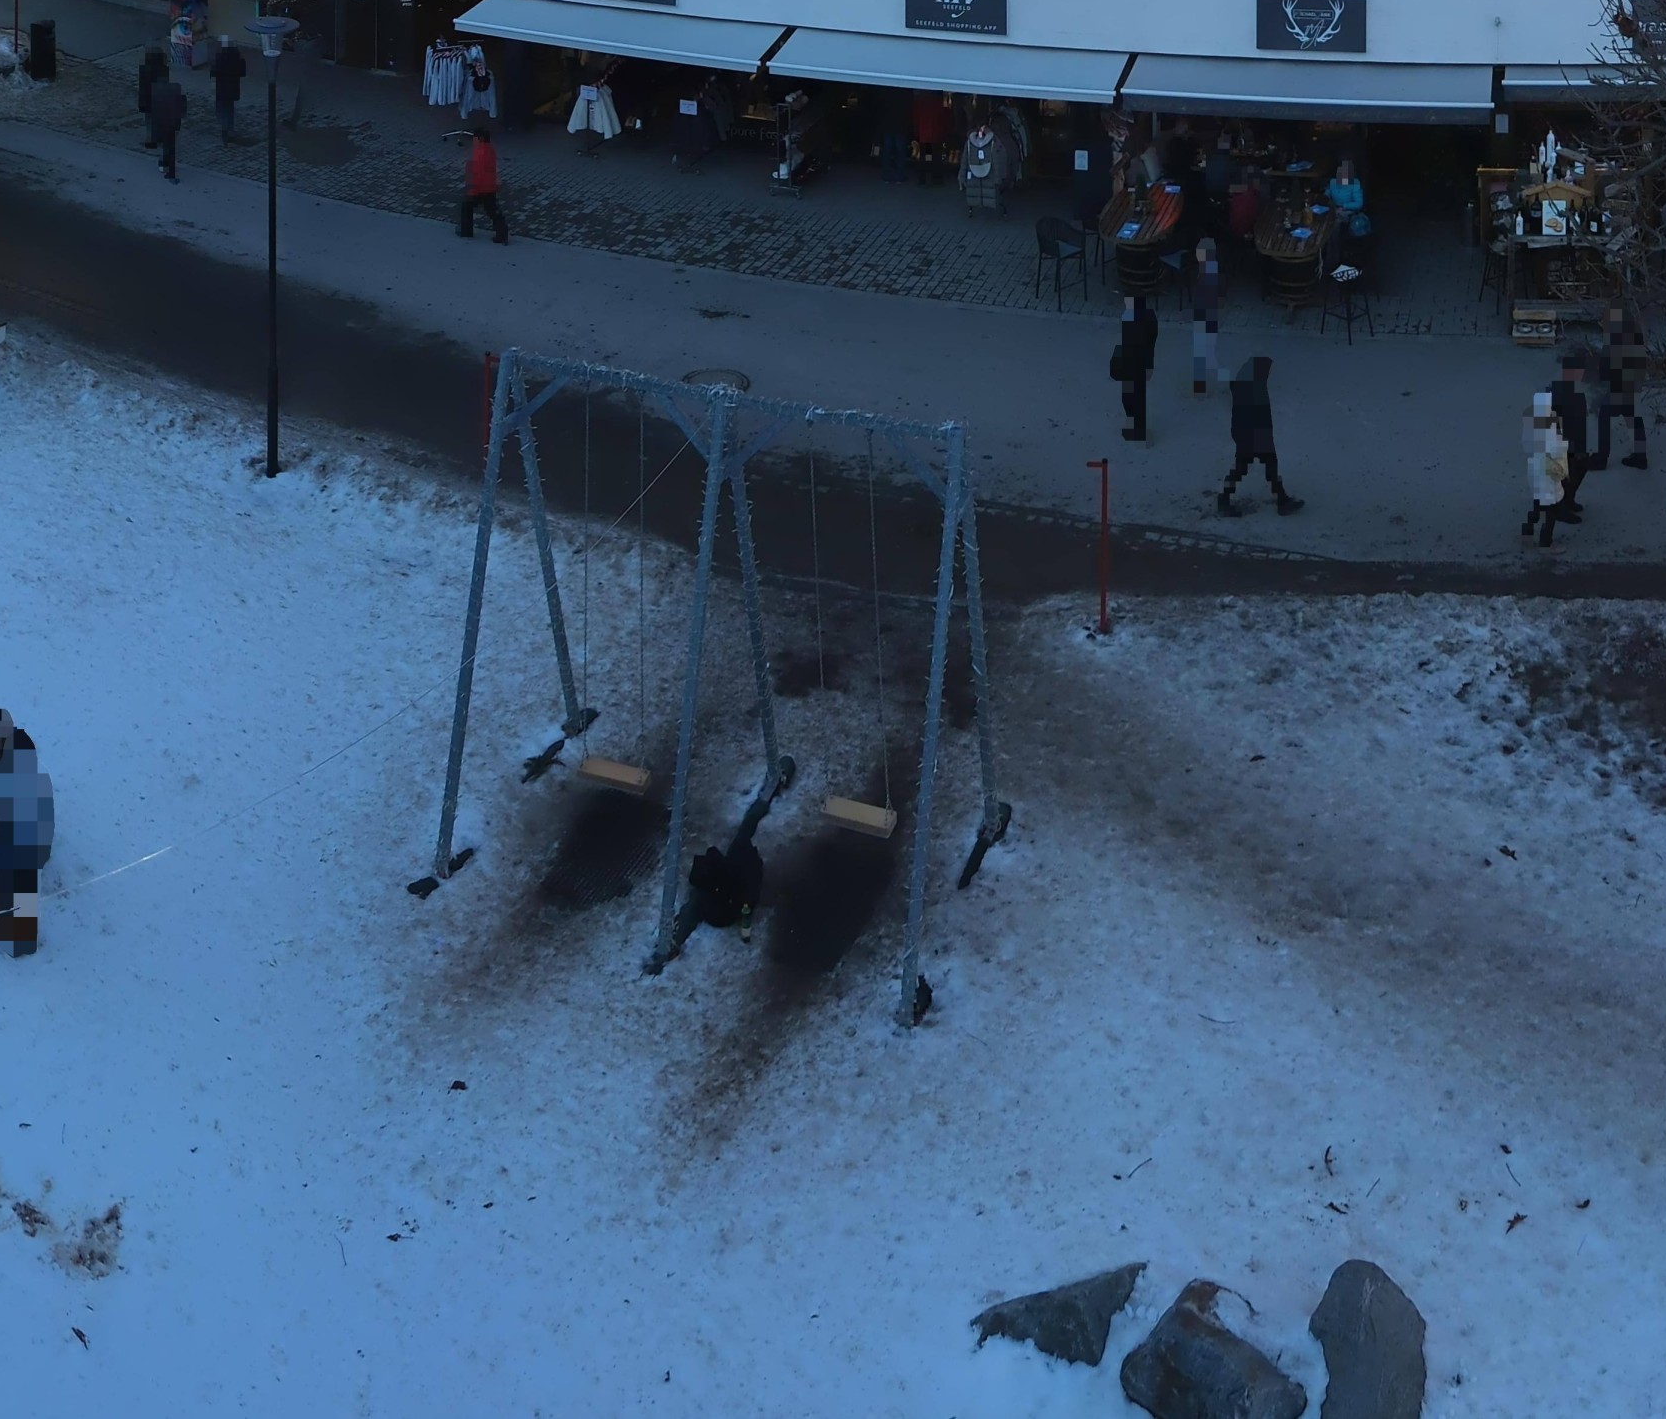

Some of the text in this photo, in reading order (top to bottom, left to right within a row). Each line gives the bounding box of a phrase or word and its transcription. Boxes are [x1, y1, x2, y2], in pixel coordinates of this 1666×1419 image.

[942, 3, 972, 12] SEEFELD
[915, 19, 945, 28] SEEFELD
[946, 22, 982, 31] SHOPPING
